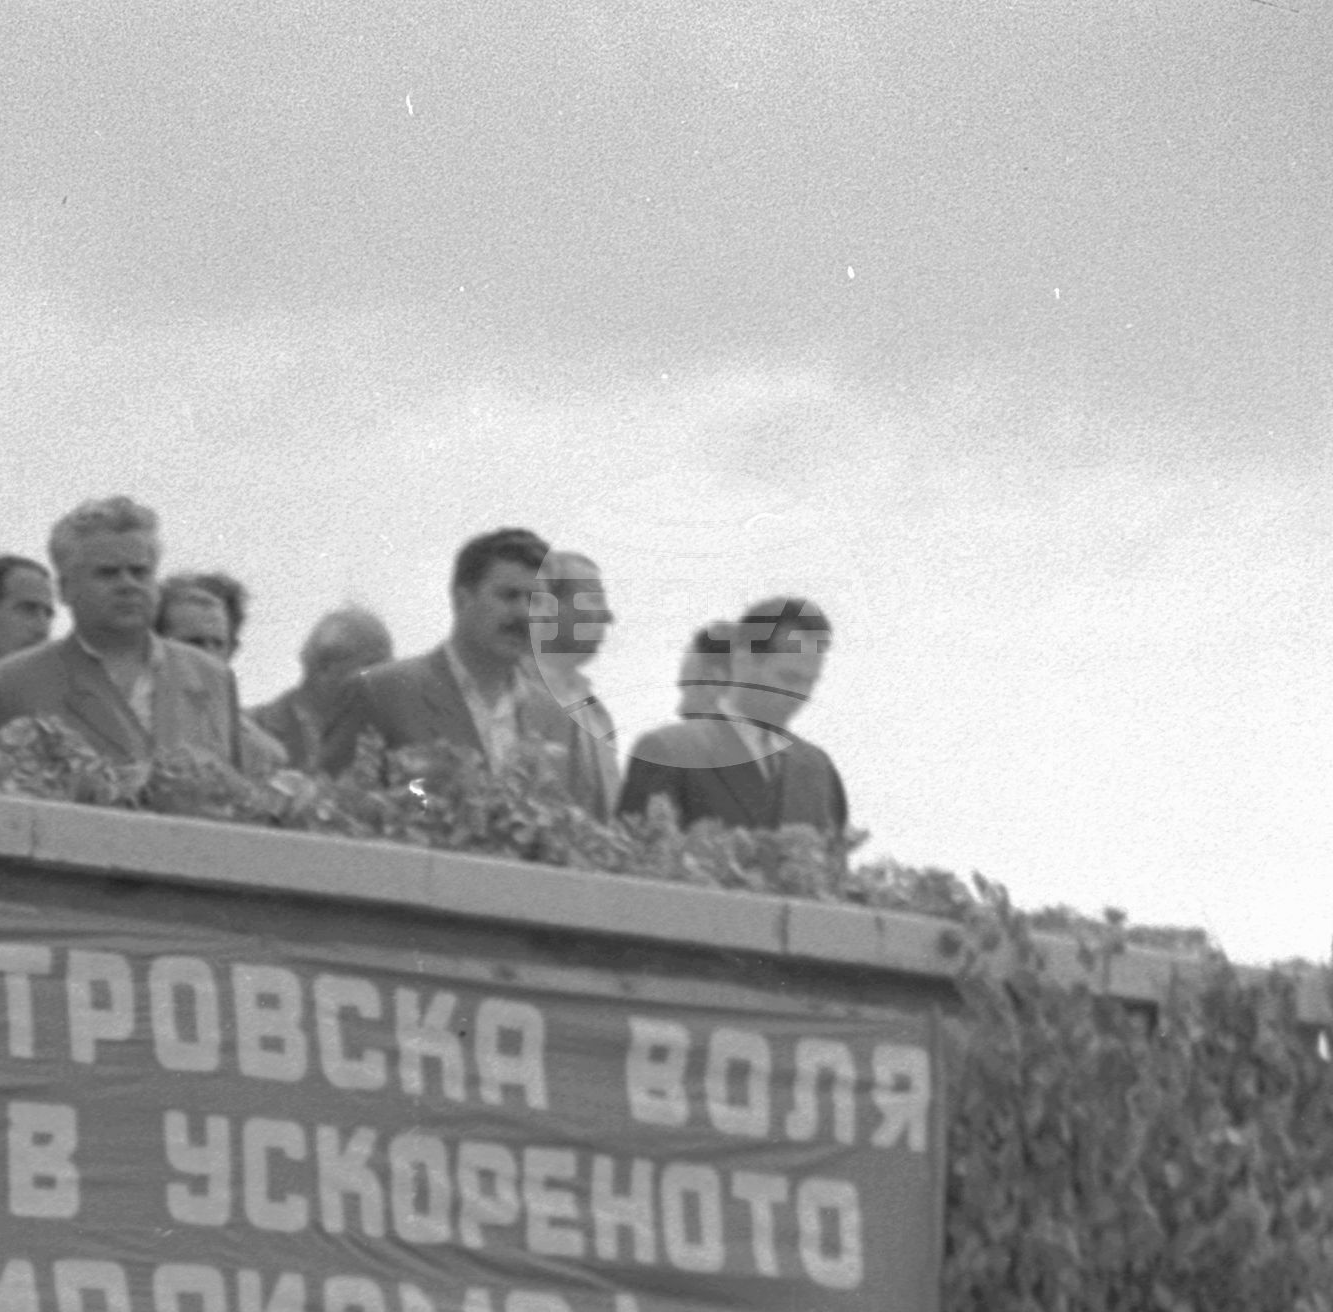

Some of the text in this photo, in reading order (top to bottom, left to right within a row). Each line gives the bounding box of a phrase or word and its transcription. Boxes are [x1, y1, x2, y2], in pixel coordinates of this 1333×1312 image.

[626, 1017, 930, 1152] ВОЛЯ
[7, 1100, 80, 1220] В
[161, 1109, 865, 1289] УСКОРЕНОТО
